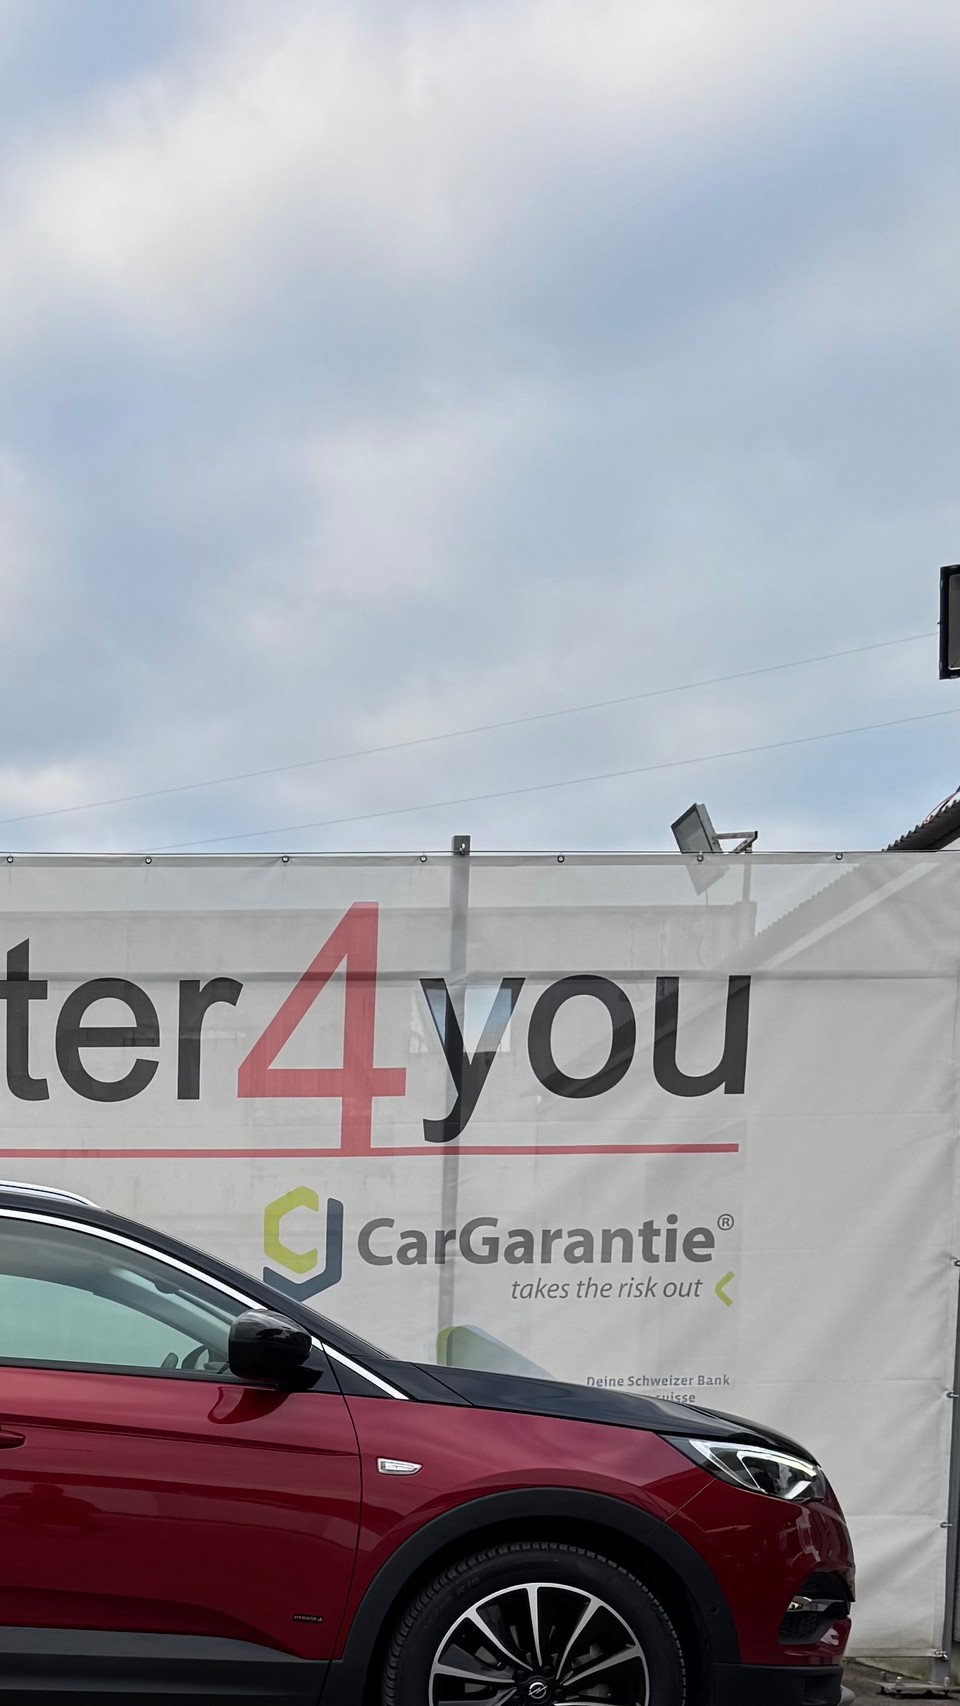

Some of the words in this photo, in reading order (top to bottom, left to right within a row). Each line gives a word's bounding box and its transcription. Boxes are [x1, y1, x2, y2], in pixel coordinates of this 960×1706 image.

[511, 1277, 570, 1300] takes
[575, 1276, 612, 1299] the
[618, 1275, 658, 1298] risk
[663, 1279, 703, 1298] out
[586, 1376, 624, 1387] Deine
[627, 1375, 694, 1387] Schweizer
[697, 1374, 730, 1386] Bank
